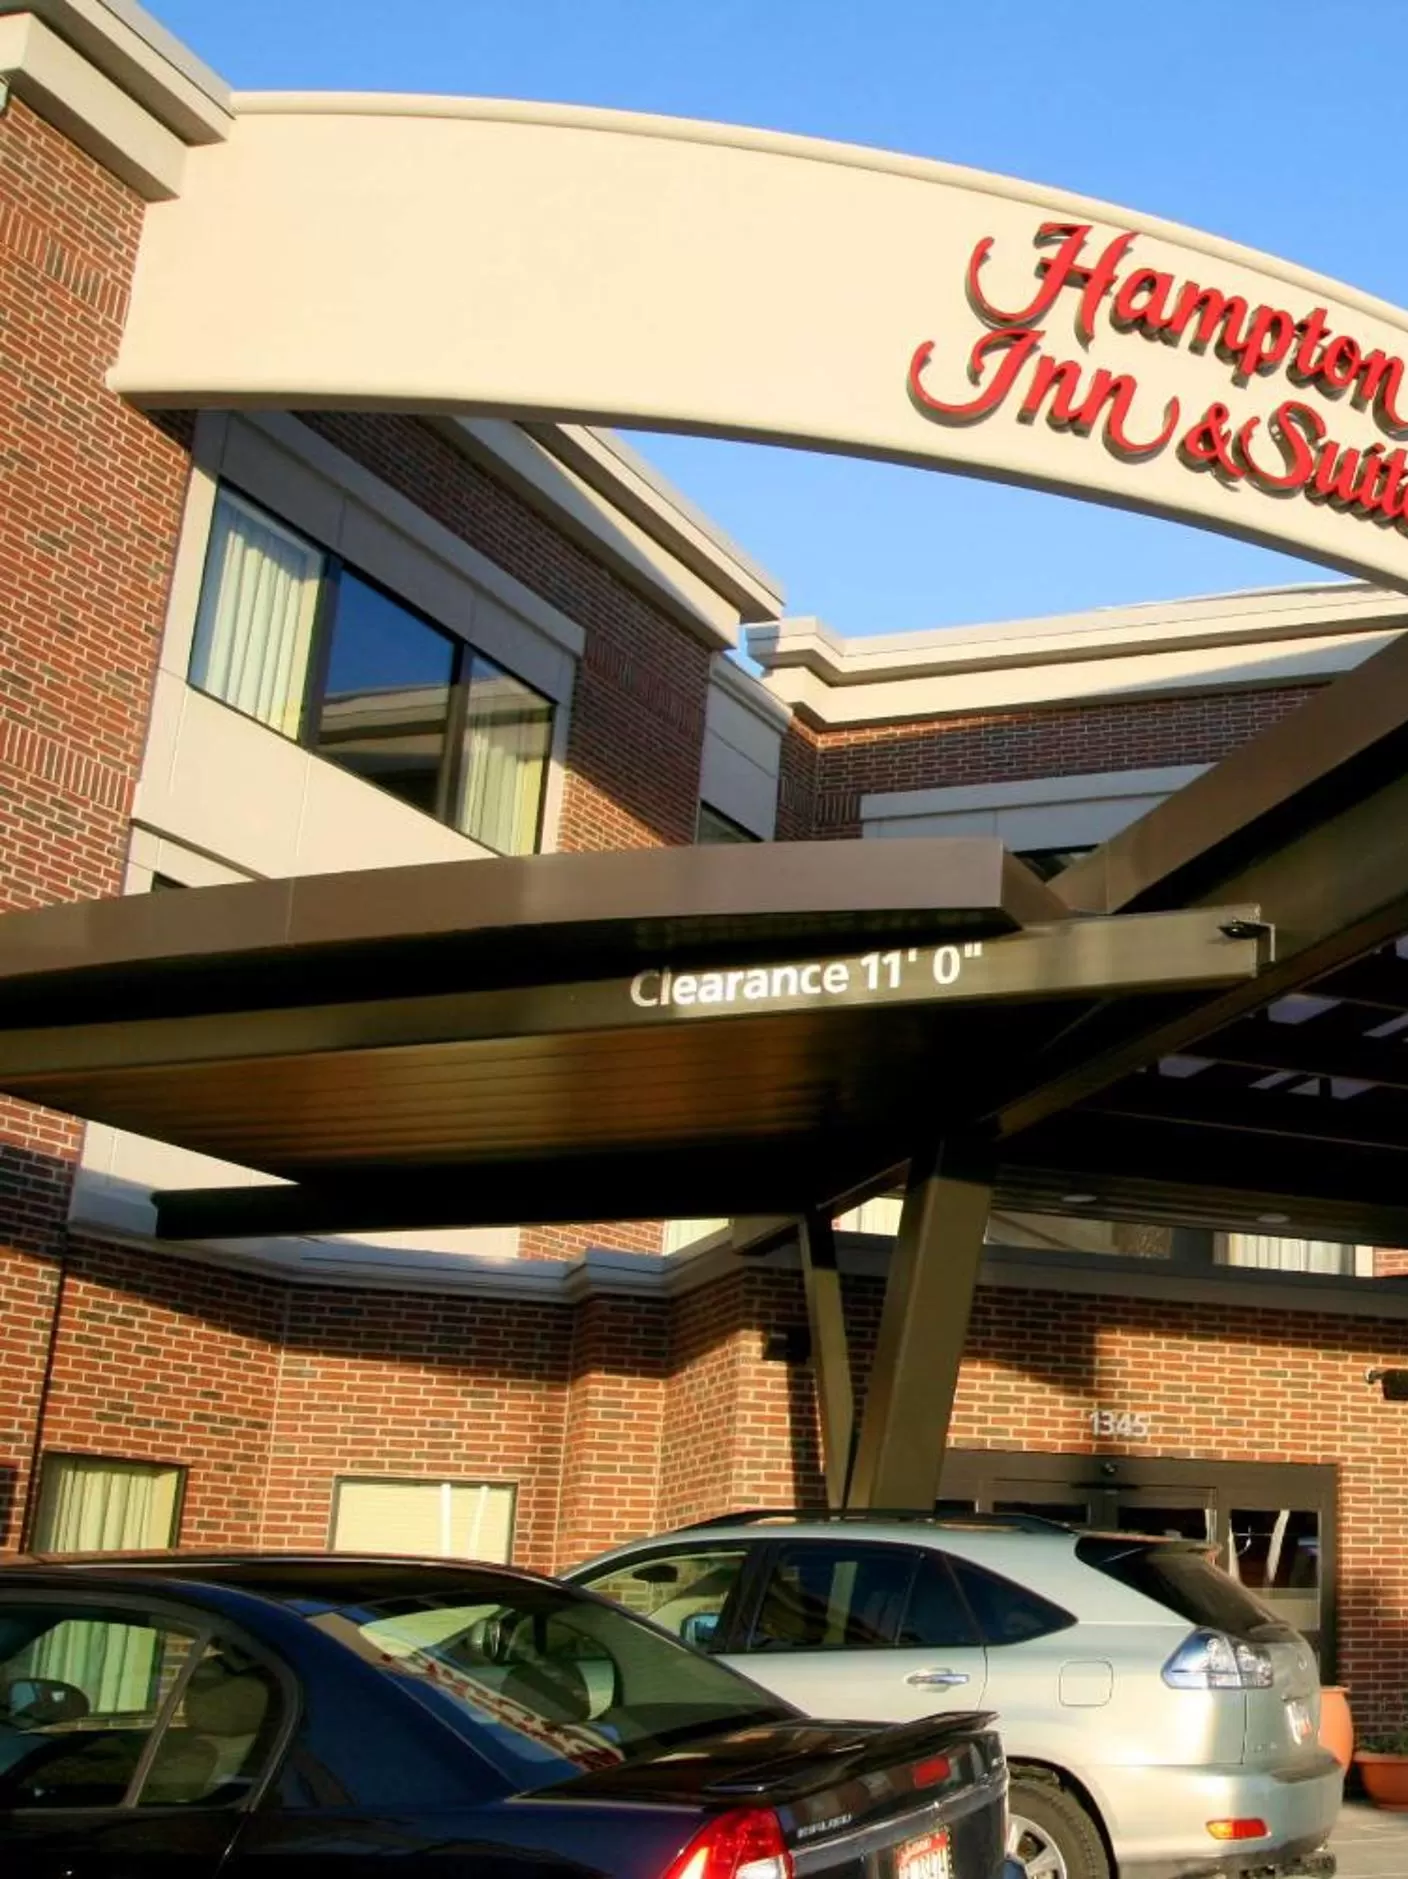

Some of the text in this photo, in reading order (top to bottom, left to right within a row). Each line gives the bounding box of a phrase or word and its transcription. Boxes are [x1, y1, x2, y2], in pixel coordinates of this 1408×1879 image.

[908, 328, 1180, 460] Inn
[1177, 402, 1245, 478] &
[630, 941, 984, 1008] Clearance 11' 0"
[1089, 1410, 1148, 1437] 1345
